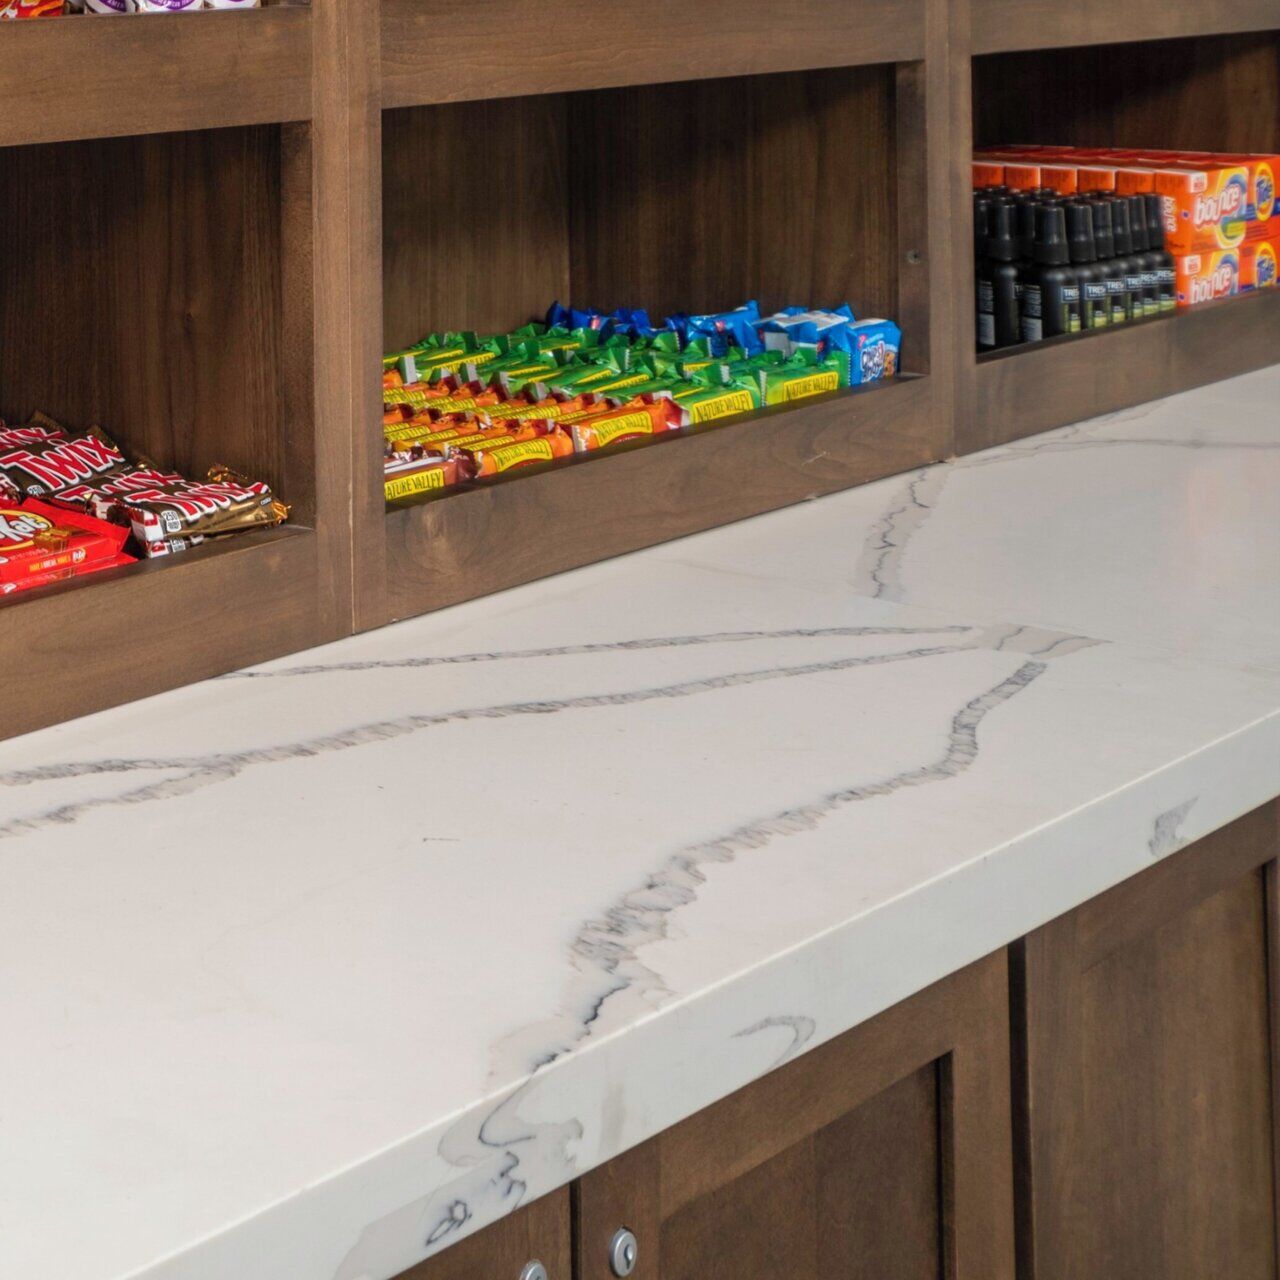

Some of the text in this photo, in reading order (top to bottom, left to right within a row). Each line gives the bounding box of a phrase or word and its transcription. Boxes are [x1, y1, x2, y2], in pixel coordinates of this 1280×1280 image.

[1192, 182, 1242, 229] bounce
[1189, 263, 1235, 304] bounce
[786, 372, 838, 401] NATURE VALLEY
[696, 393, 752, 423] NATURE VALLEY
[596, 413, 651, 440] NATURE VALLEY
[496, 439, 550, 467] NATURE VALLEY
[53, 468, 187, 504] TWIX
[414, 472, 442, 491] VALLEY
[125, 480, 272, 523] TWIX
[162, 511, 177, 522] 250
